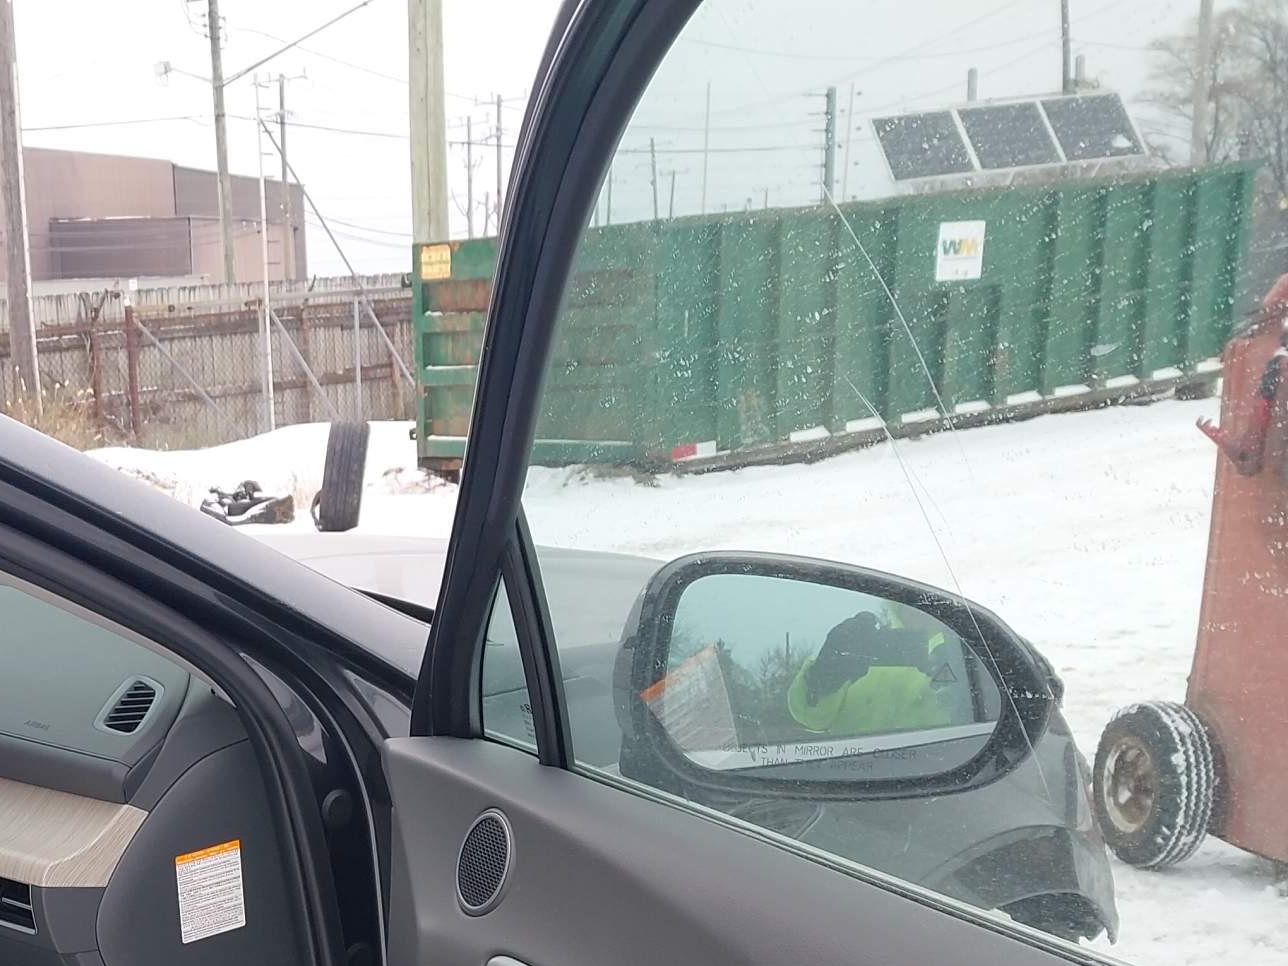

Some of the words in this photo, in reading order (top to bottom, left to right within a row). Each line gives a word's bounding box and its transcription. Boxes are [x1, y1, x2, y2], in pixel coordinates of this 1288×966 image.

[776, 743, 786, 755] IN
[794, 744, 834, 757] MIRROR
[843, 746, 864, 758] ARE
